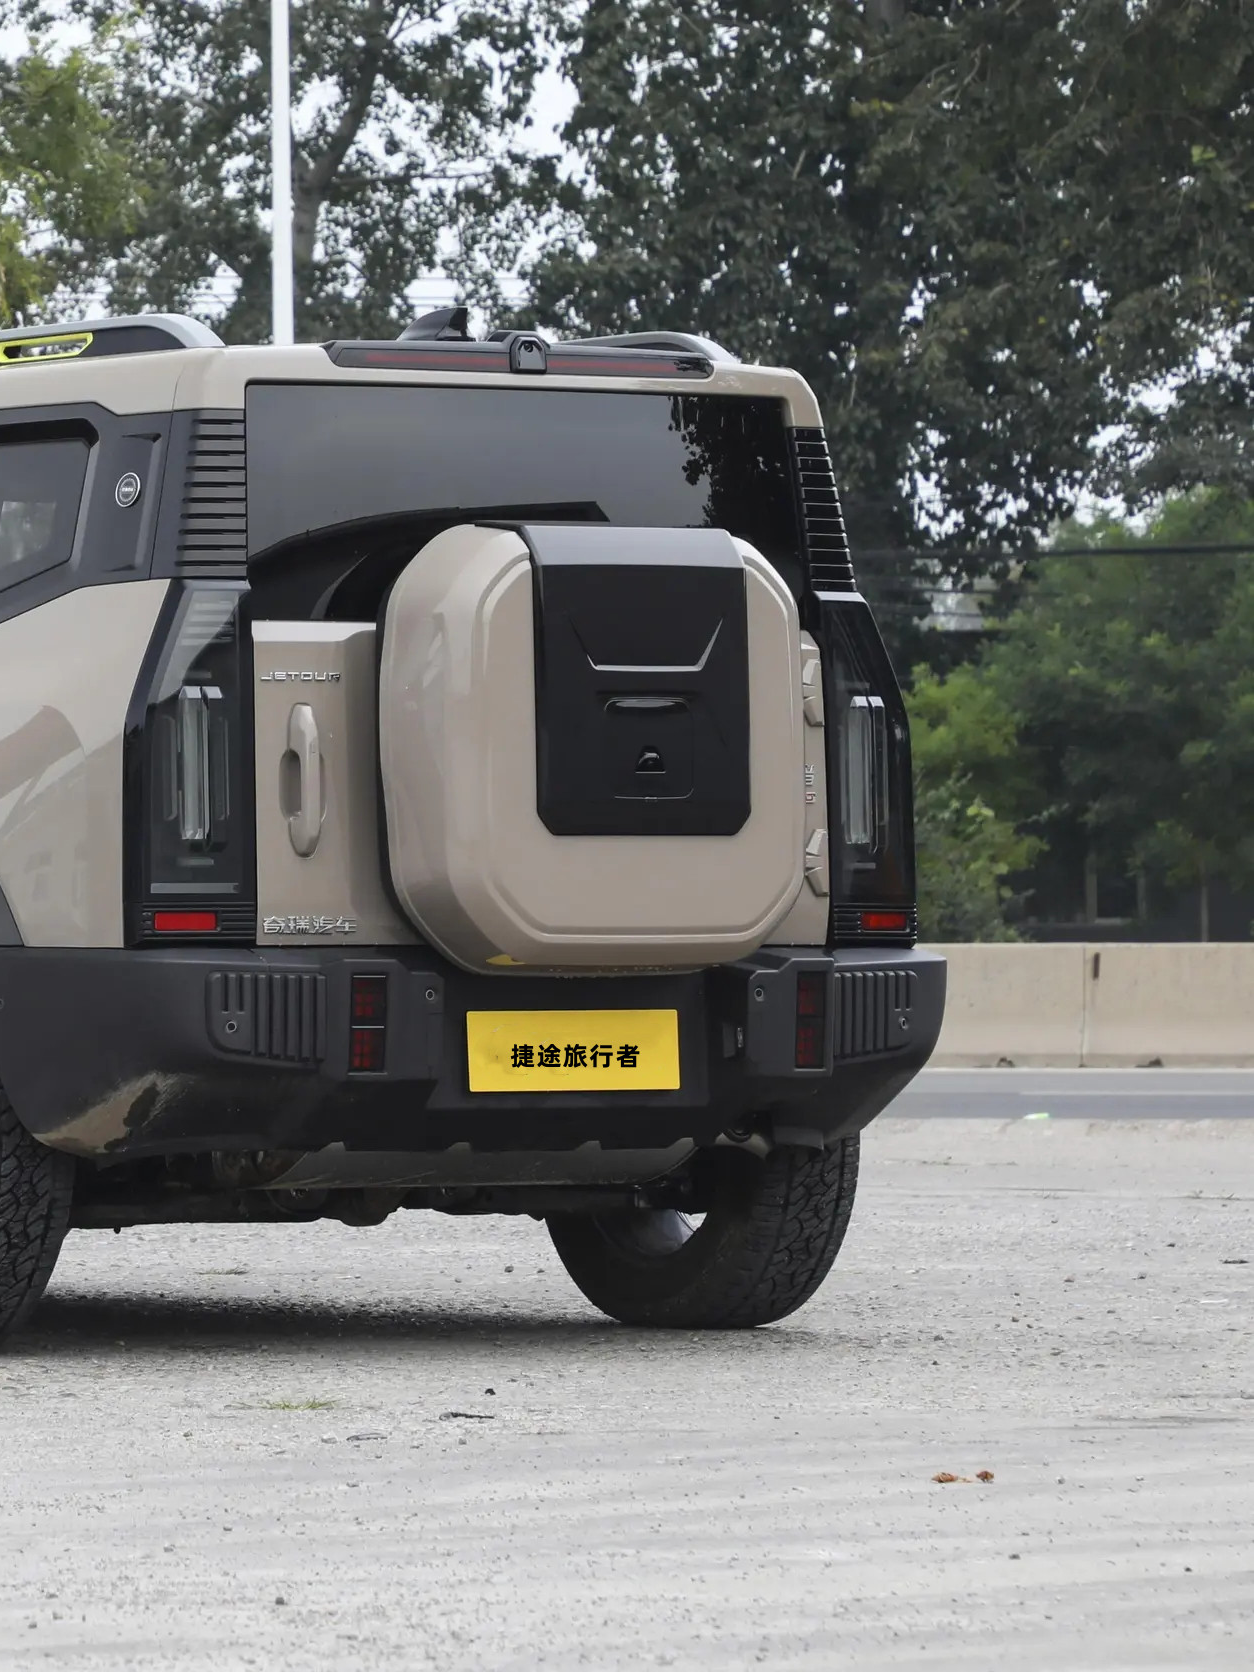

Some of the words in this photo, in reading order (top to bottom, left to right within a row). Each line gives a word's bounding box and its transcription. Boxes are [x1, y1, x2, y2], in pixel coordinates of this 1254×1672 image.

[260, 671, 341, 682] JETOUR
[262, 915, 357, 935] 奇瑞汽车
[510, 1043, 641, 1069] 捷途旅行者
